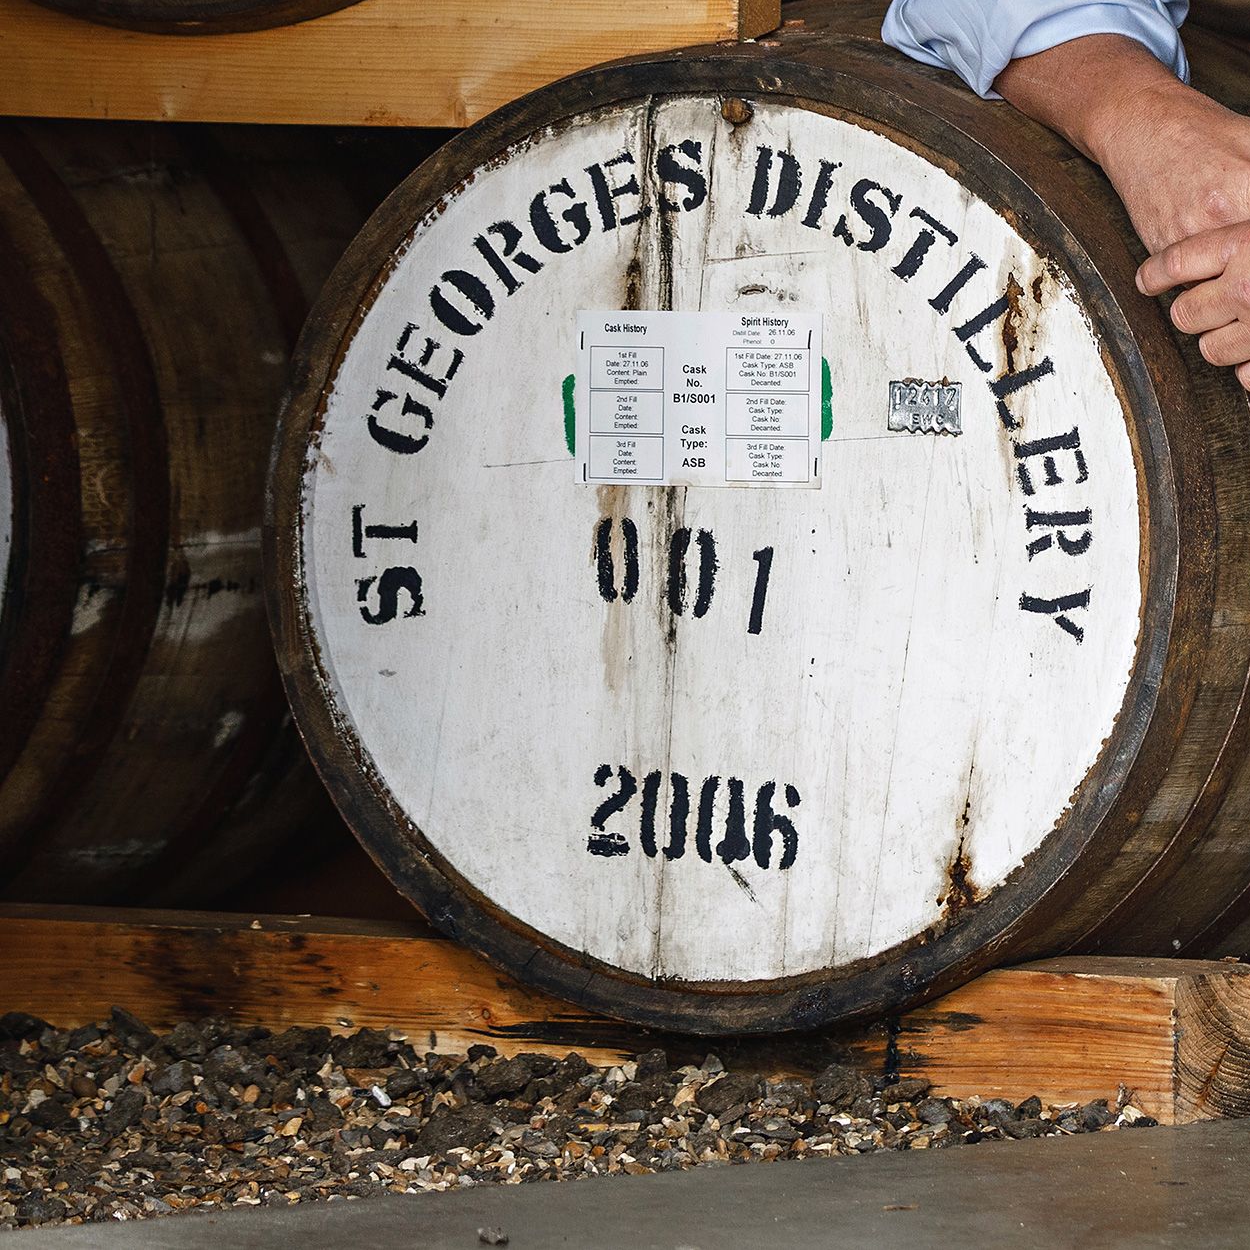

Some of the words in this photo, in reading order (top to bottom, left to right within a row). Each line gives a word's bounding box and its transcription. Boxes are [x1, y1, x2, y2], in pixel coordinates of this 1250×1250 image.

[369, 140, 707, 454] GEORGES
[741, 316, 761, 328] Spirit
[762, 317, 789, 328] History
[604, 323, 623, 333] Cask
[623, 323, 648, 336] History
[735, 352, 744, 360] 1st
[746, 352, 754, 360] Fill
[774, 353, 803, 361] 27.11.06
[622, 360, 649, 368] 27.11.06
[632, 369, 648, 377] Plain
[682, 365, 707, 375] Cask
[769, 370, 797, 378] B1/S001
[686, 378, 703, 388] No.
[673, 394, 716, 404] B1/S001
[748, 145, 1094, 644] DISTILLERY
[748, 406, 766, 414] Cask
[910, 413, 944, 426] EWC
[681, 425, 707, 435] Cask
[616, 441, 626, 449] 3rd
[627, 441, 636, 449] Fill
[680, 439, 708, 450] Type:
[748, 452, 766, 460] Cask
[682, 458, 706, 468] ASB
[352, 504, 426, 625] ST
[595, 515, 775, 636] 001
[586, 764, 802, 871] 2006
